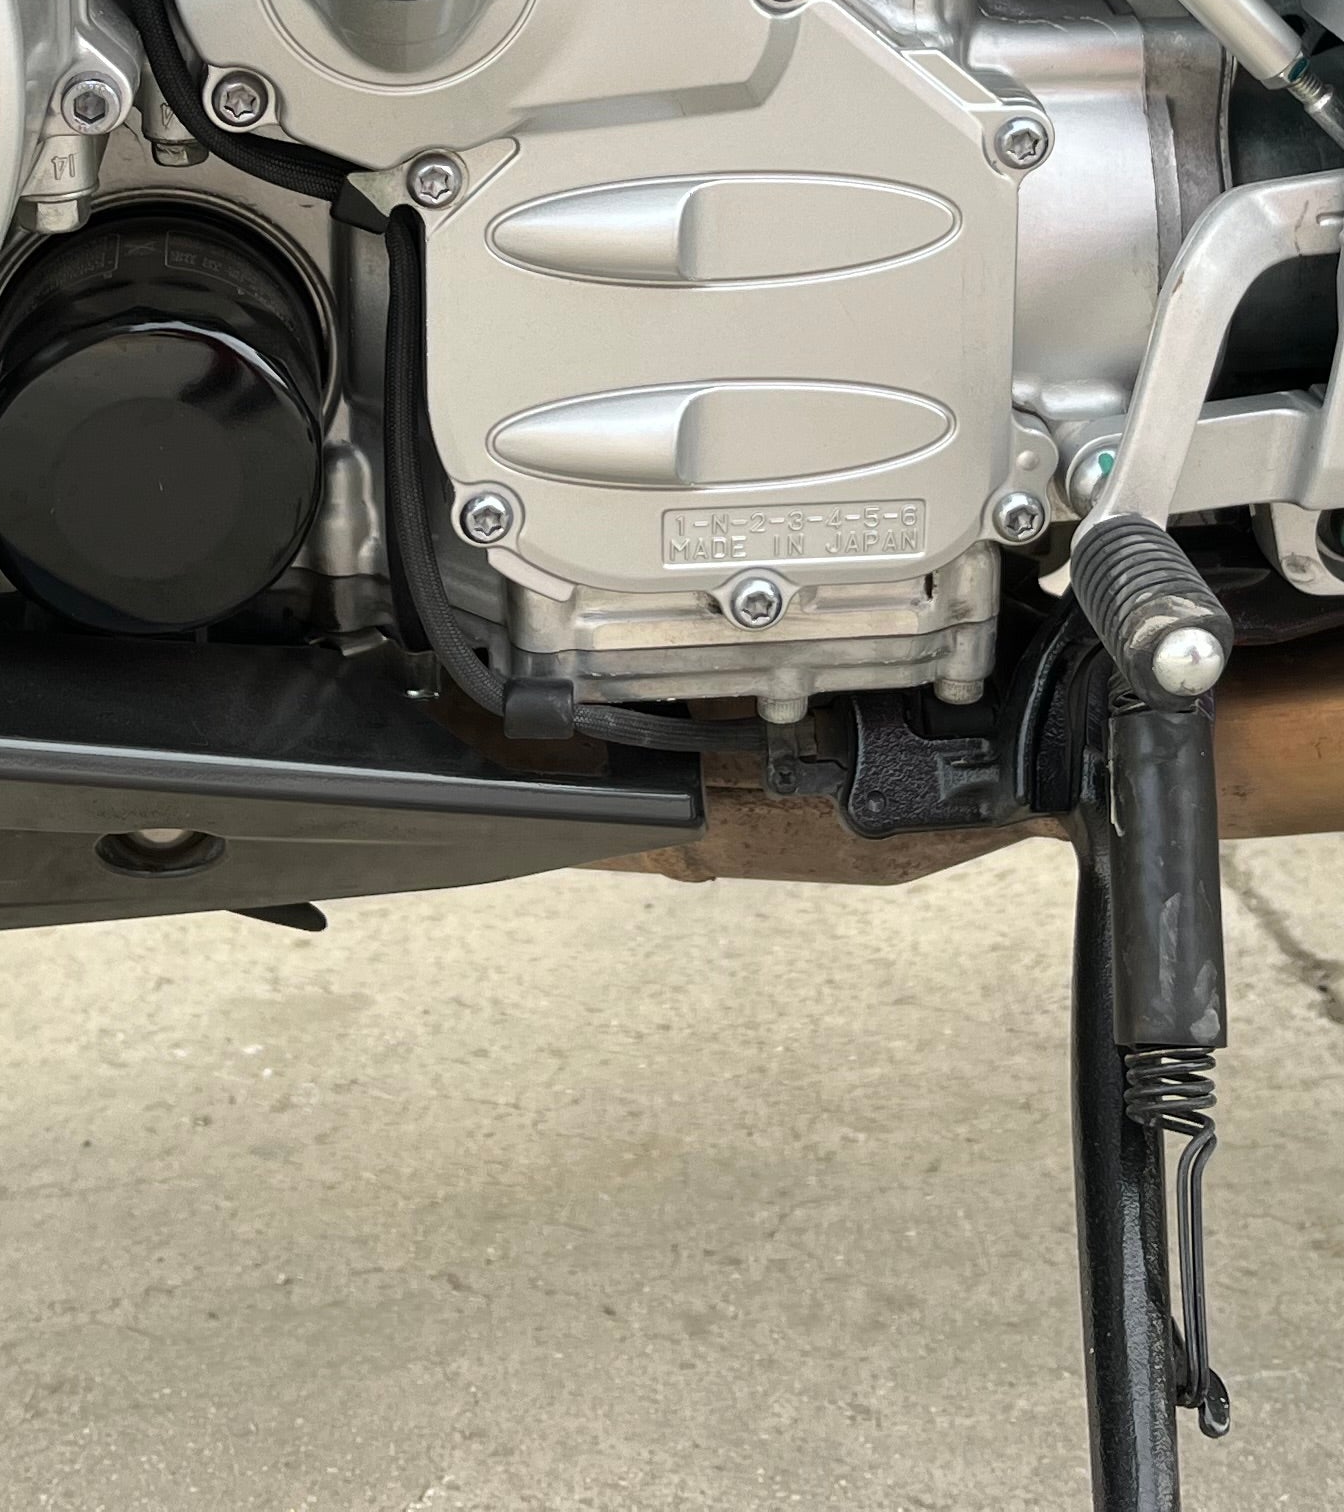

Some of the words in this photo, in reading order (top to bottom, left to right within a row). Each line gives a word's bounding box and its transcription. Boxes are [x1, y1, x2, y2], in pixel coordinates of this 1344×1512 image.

[668, 534, 748, 562] MADE
[772, 532, 805, 557] IN
[824, 527, 920, 555] JAPAN
